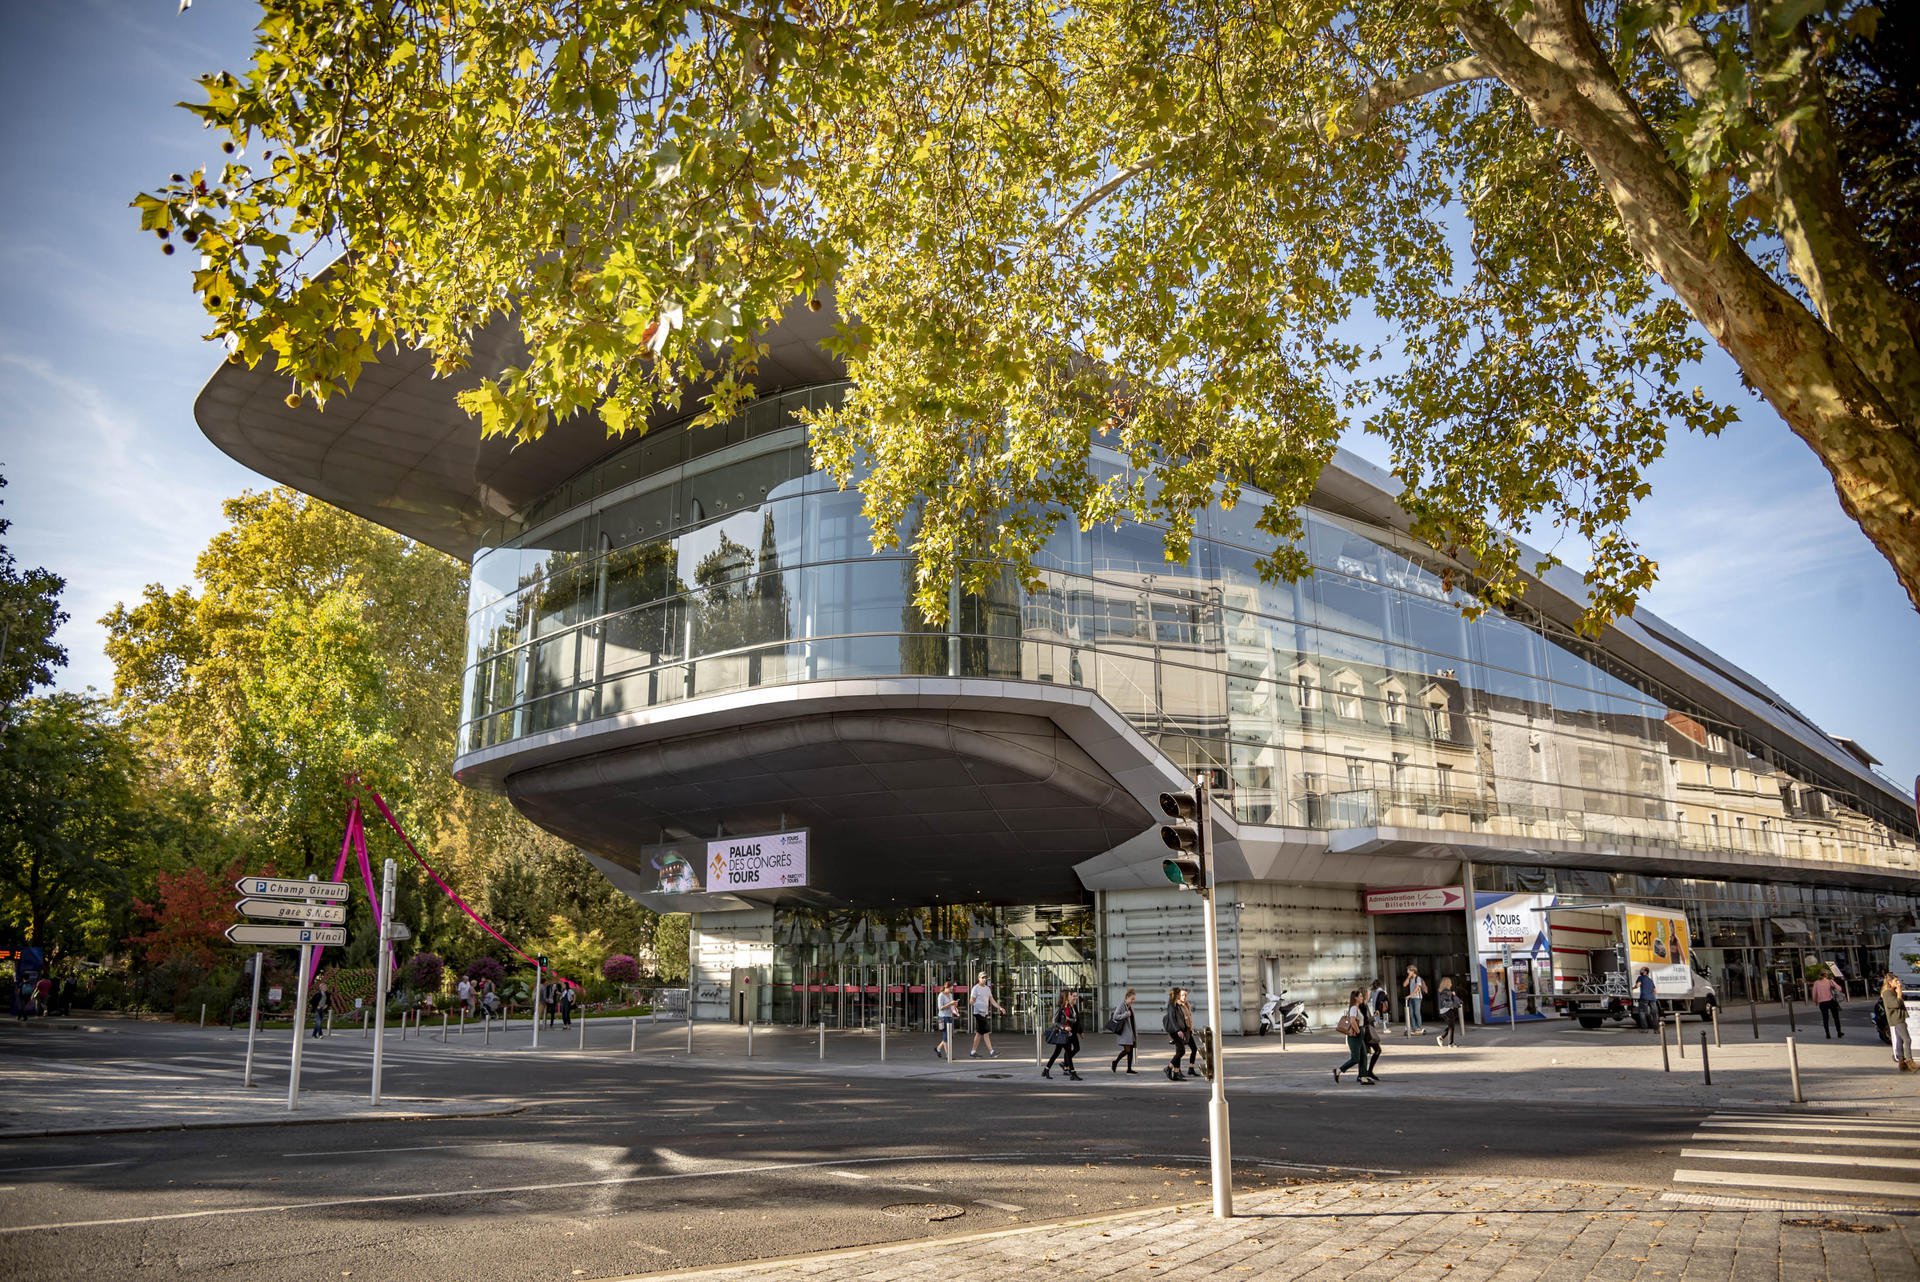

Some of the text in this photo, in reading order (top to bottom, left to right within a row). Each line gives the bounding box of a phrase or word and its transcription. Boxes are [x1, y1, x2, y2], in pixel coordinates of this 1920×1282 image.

[729, 844, 761, 858] PALAIS
[729, 851, 792, 871] DES CONGRÈS
[729, 870, 760, 884] TOURS
[270, 884, 304, 895] Champ
[309, 886, 345, 896] Girault
[1368, 895, 1415, 903] Administration
[278, 907, 301, 917] gare
[1496, 914, 1521, 925] TOURS
[315, 931, 342, 941] Vinci
[1630, 929, 1652, 946] ucar
